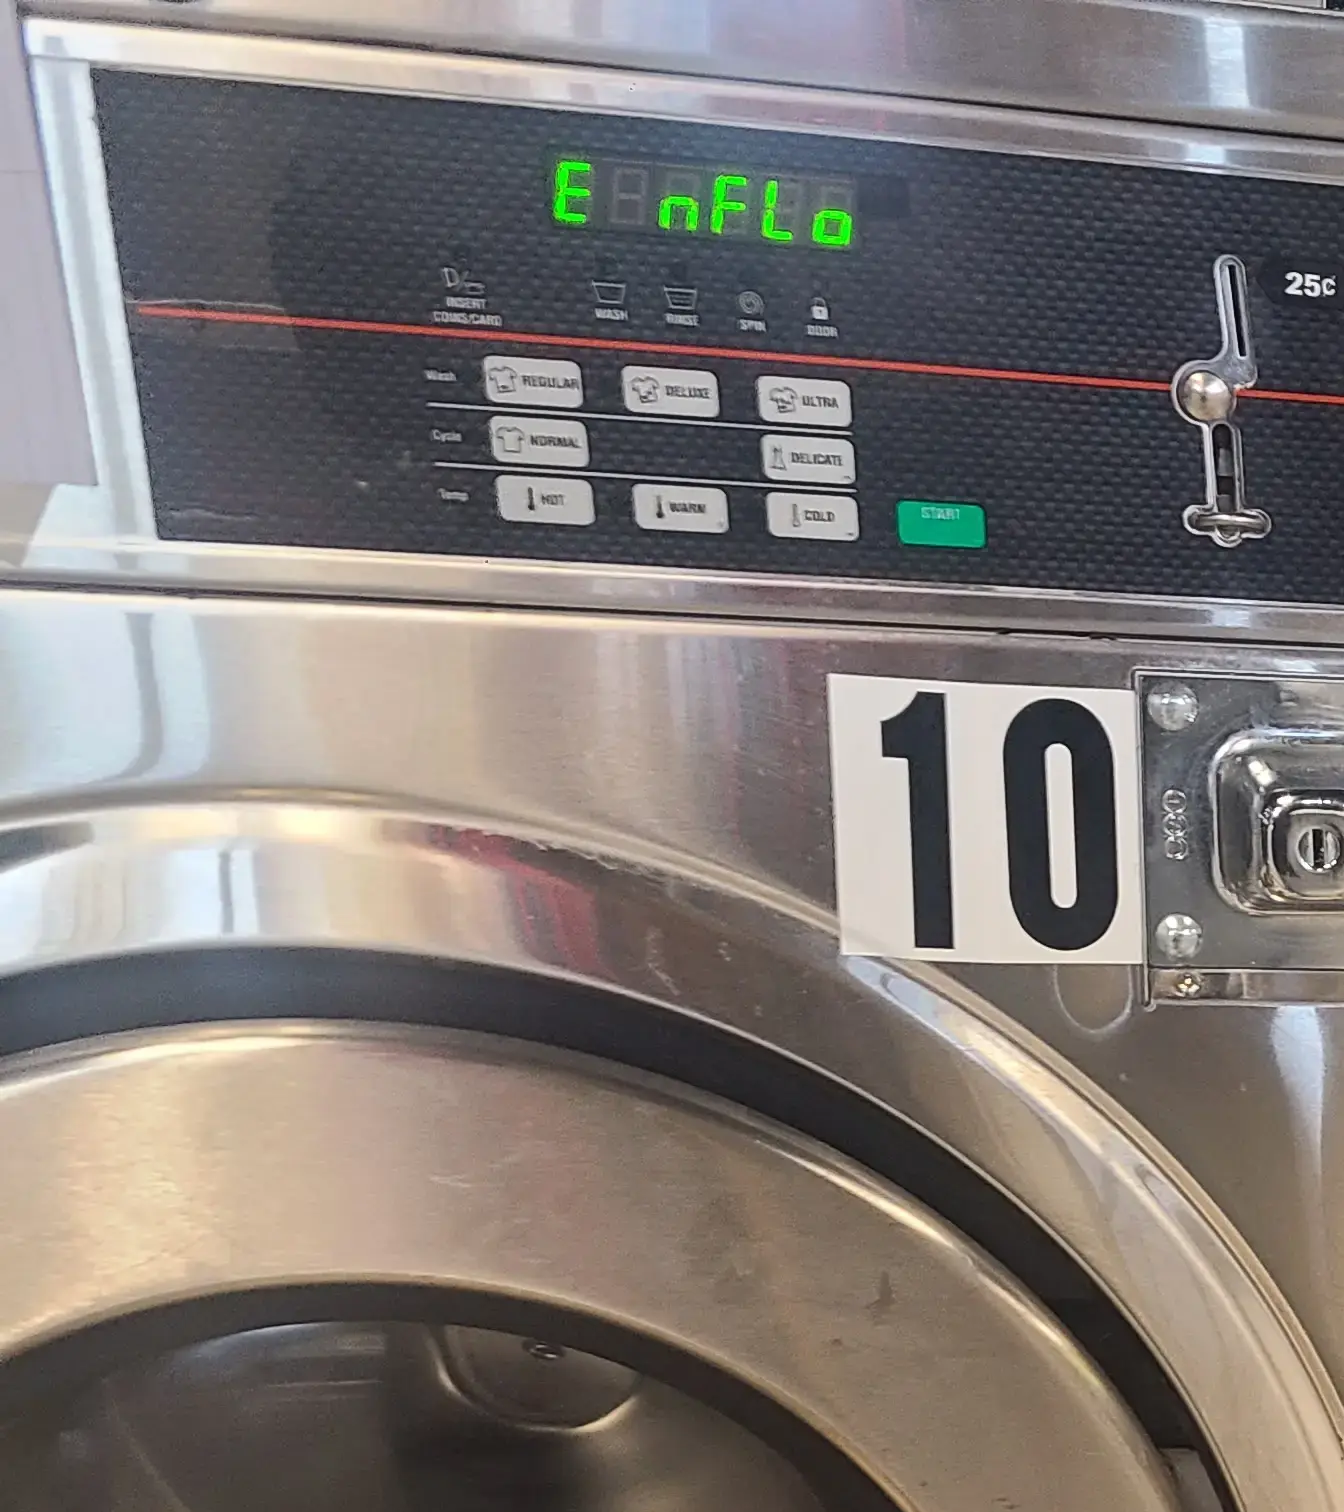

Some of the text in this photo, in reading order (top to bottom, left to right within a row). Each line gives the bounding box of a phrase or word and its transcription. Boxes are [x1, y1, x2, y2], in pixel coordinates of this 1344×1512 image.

[553, 160, 592, 225] E
[595, 308, 628, 321] WASH
[521, 375, 580, 390] REGULAR
[665, 384, 710, 400] DELUXE
[801, 396, 839, 410] ULTRA
[530, 435, 582, 449] NORMAL
[791, 451, 843, 467] DELICATE
[804, 510, 836, 523] COLD
[880, 691, 1119, 952] 10
